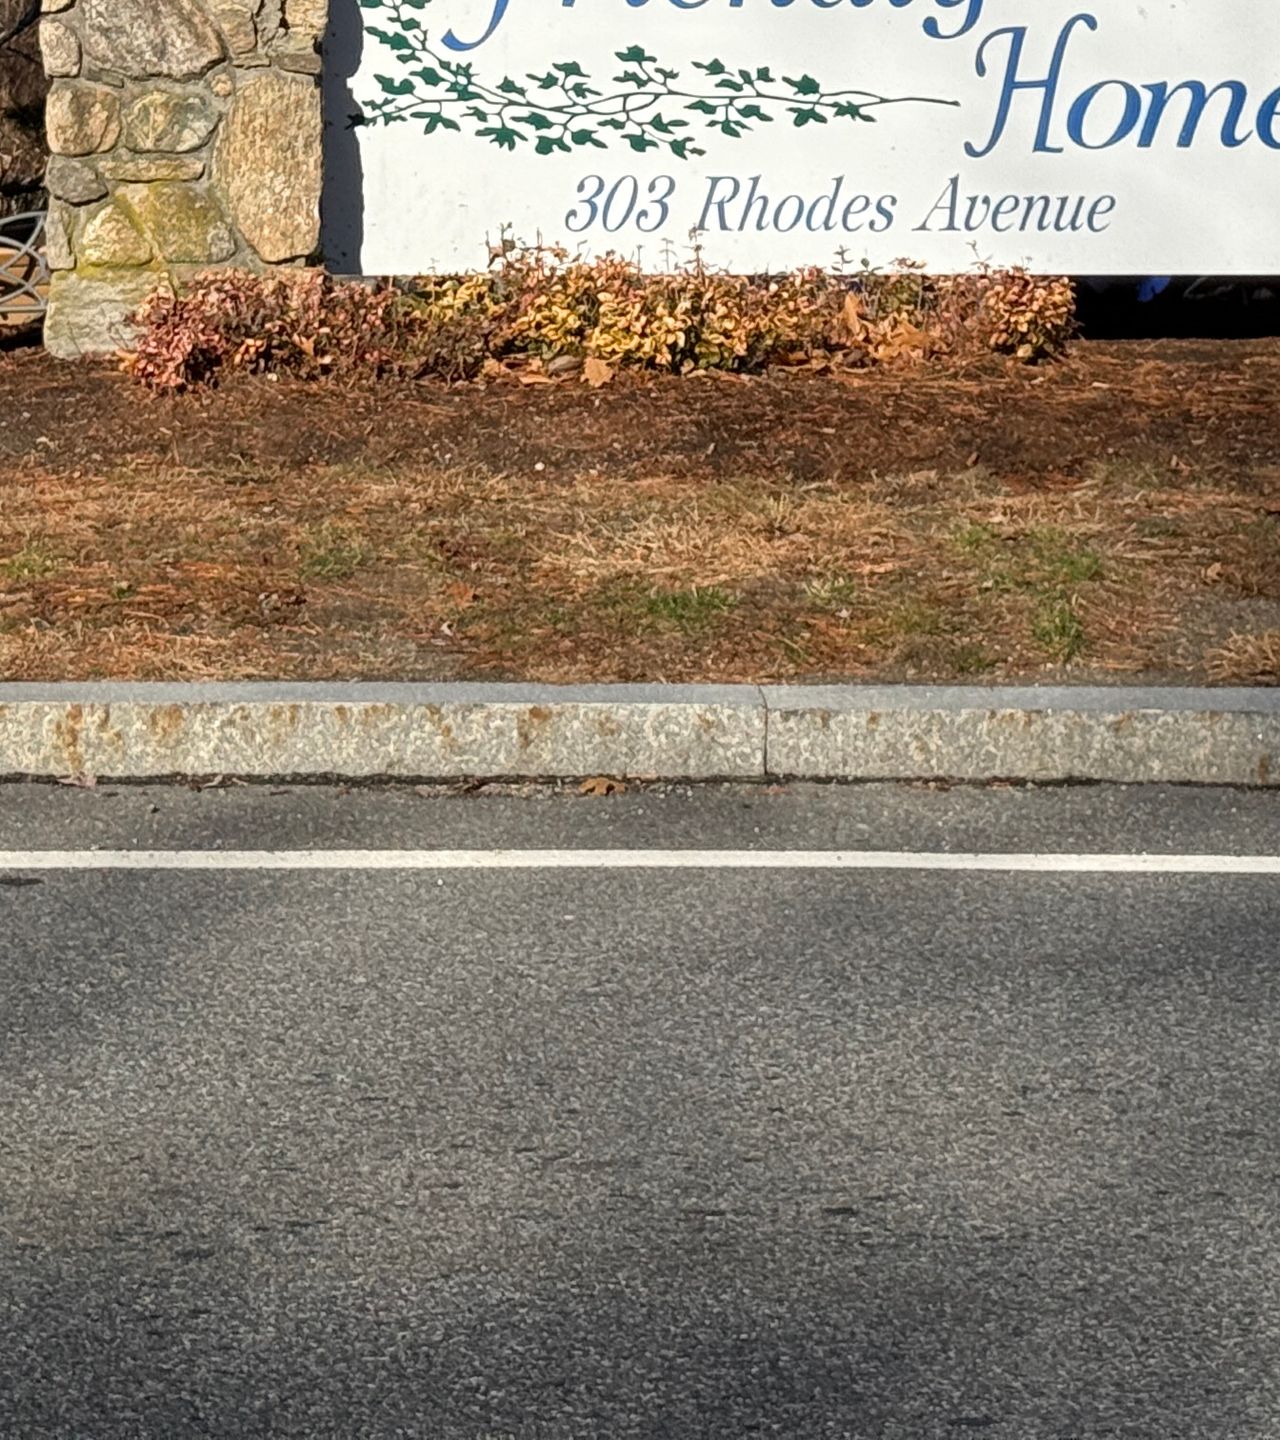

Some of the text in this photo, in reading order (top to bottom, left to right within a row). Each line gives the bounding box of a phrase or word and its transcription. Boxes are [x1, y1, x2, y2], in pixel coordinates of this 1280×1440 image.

[563, 172, 1118, 234] 303 Rhodes Avenue
